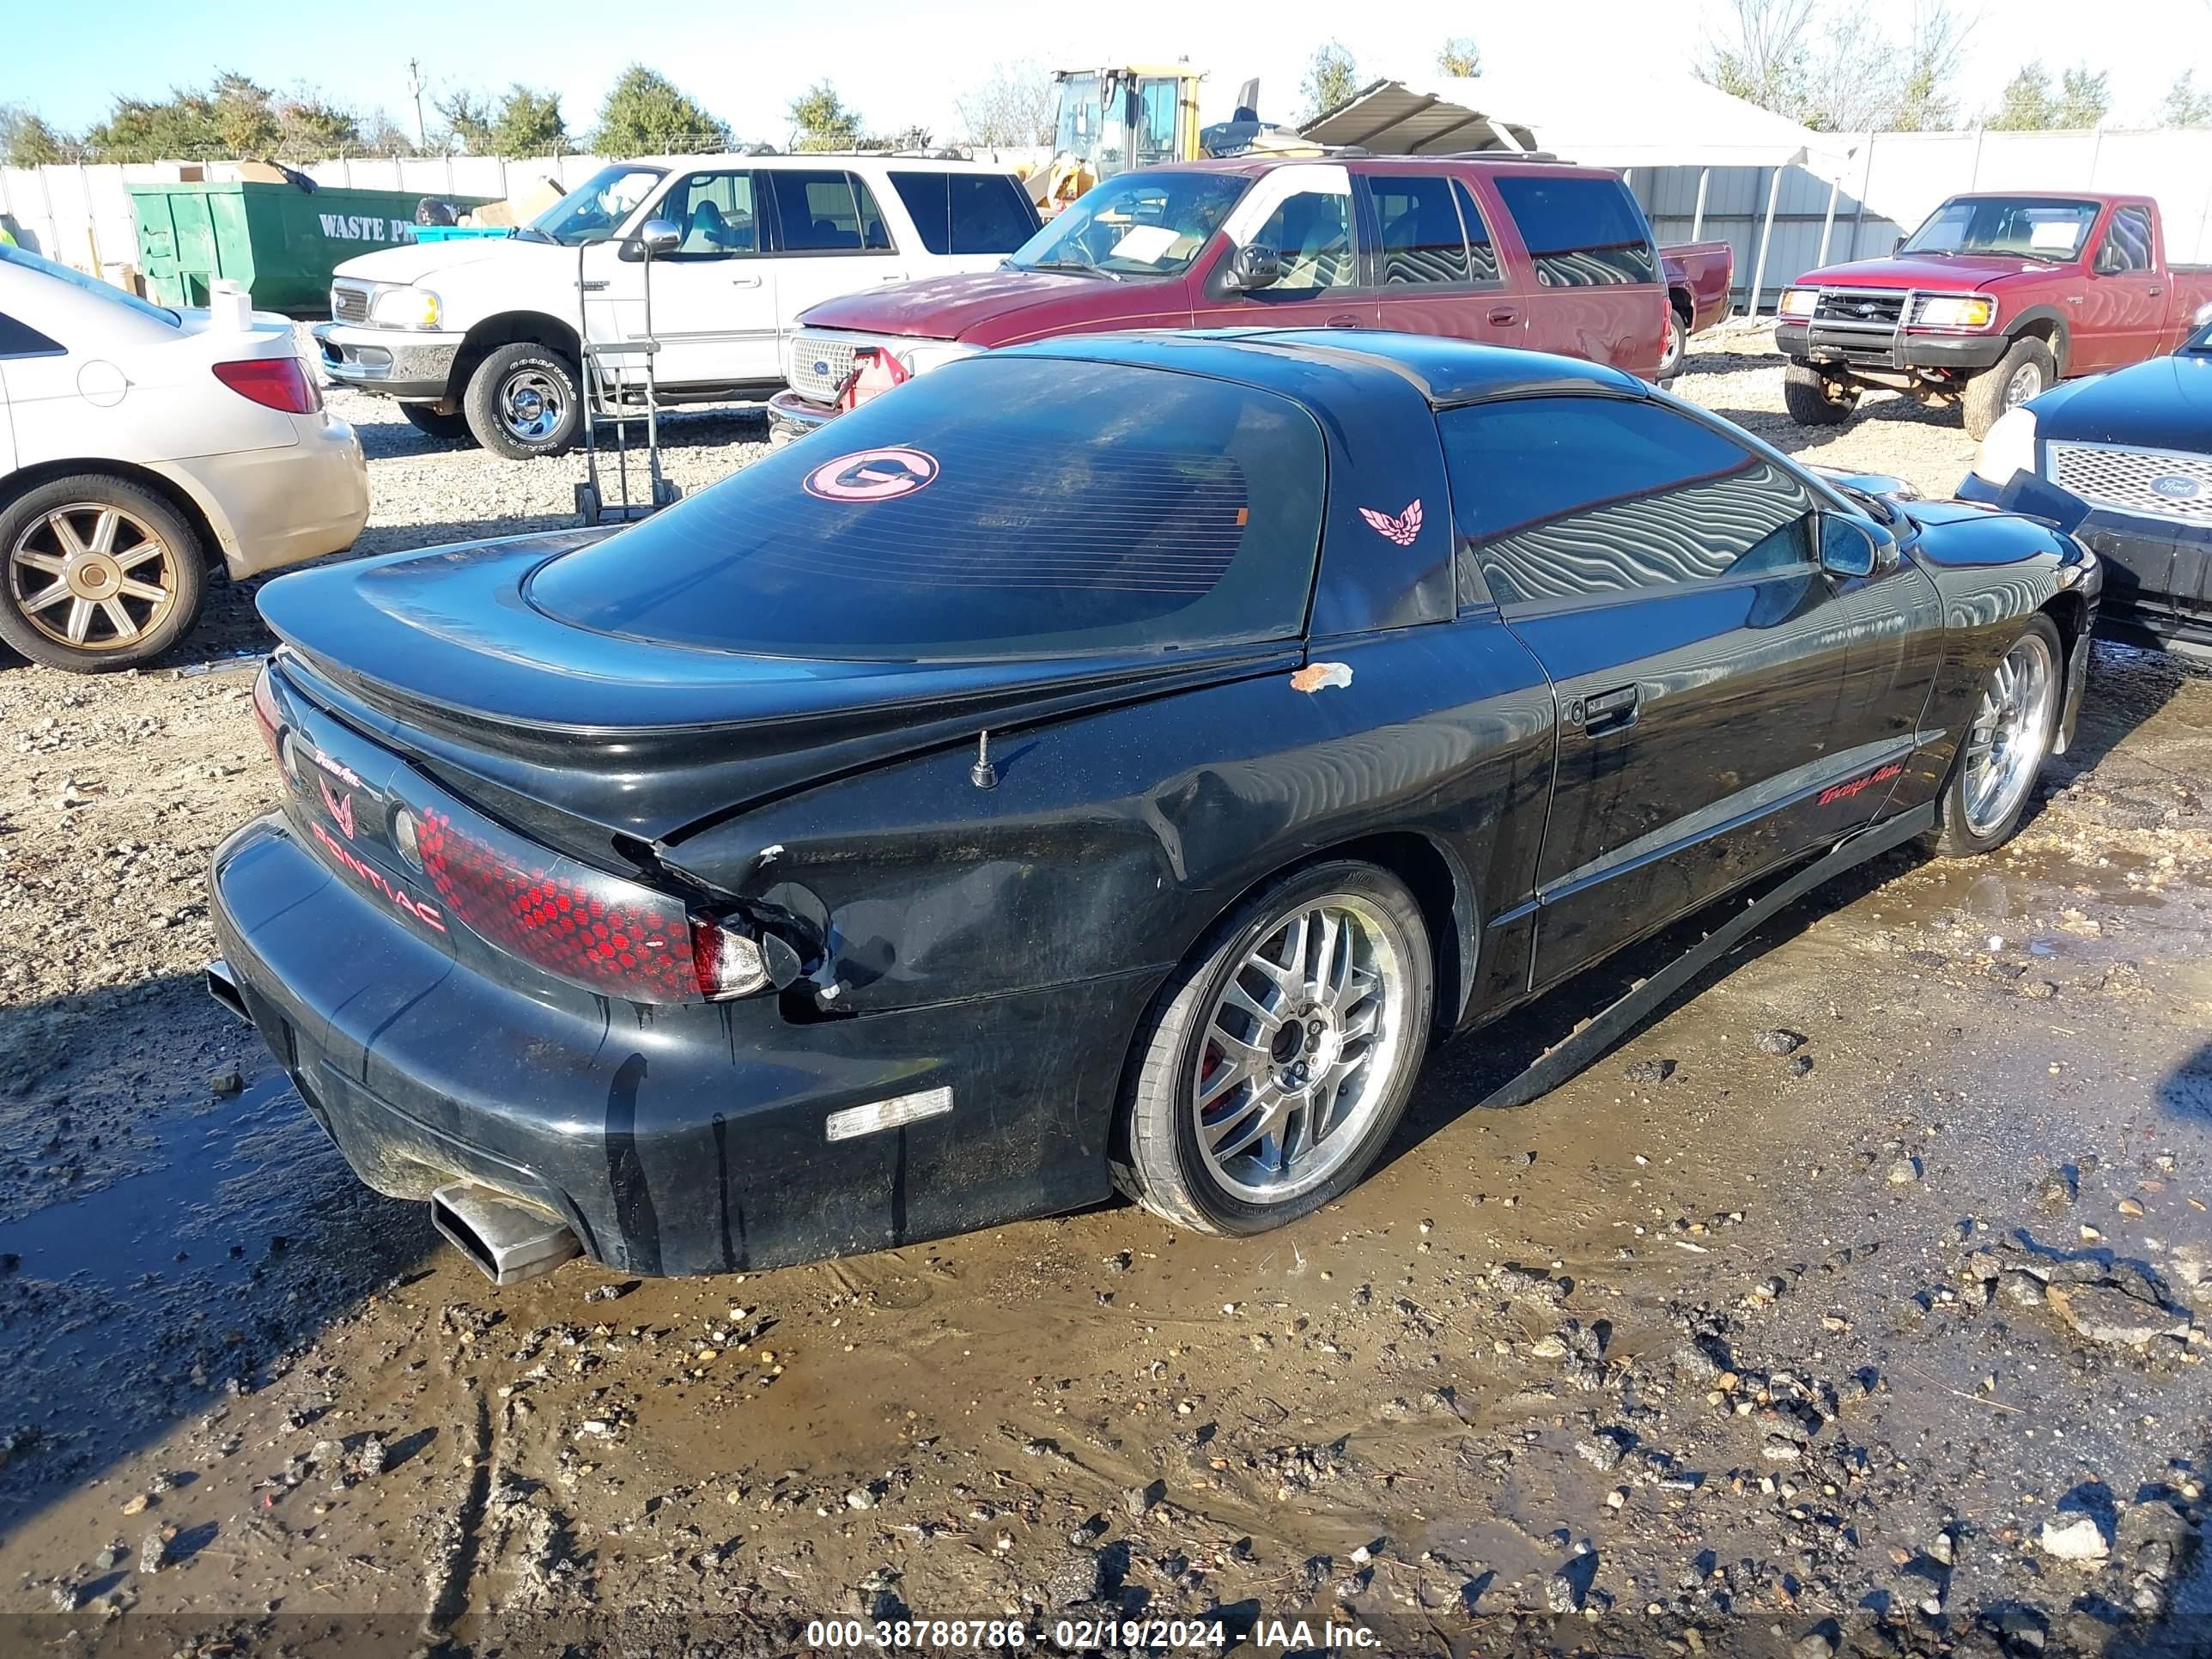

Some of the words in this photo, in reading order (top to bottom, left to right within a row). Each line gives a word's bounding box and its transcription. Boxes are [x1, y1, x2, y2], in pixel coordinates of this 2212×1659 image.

[319, 214, 386, 241] WASTE
[2159, 478, 2193, 495] Ford
[1817, 777, 1870, 805] Trans
[311, 821, 447, 933] PONTIAC
